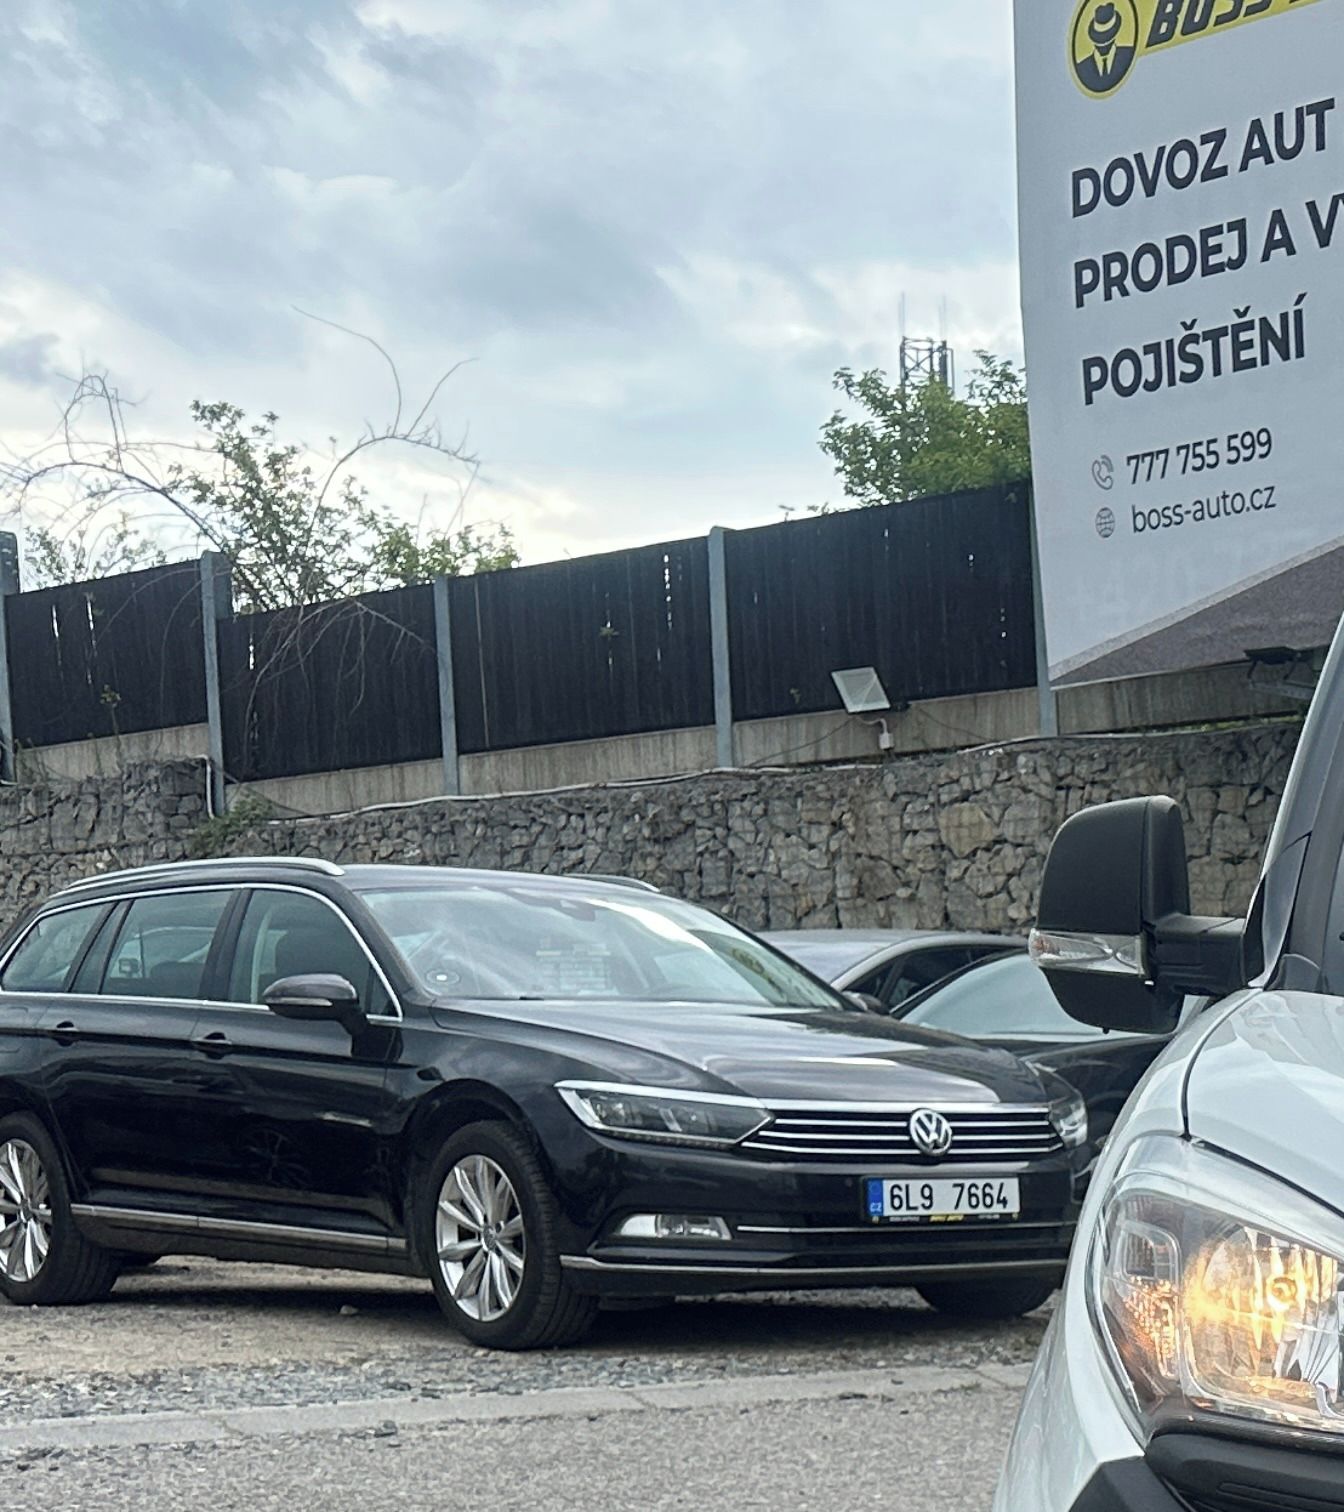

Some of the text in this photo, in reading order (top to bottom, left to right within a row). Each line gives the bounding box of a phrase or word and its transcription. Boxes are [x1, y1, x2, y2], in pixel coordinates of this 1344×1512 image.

[1070, 129, 1229, 218] DOVOZ
[1239, 97, 1335, 172] AUT
[1074, 218, 1248, 308] PRODEJ
[1260, 208, 1296, 263] A
[1082, 293, 1308, 405] POJIŠTĚNÍ
[1126, 427, 1273, 485] 777 755 599
[1132, 486, 1277, 533] boss-auto.cz
[889, 1182, 1008, 1211] 6L9 7664
